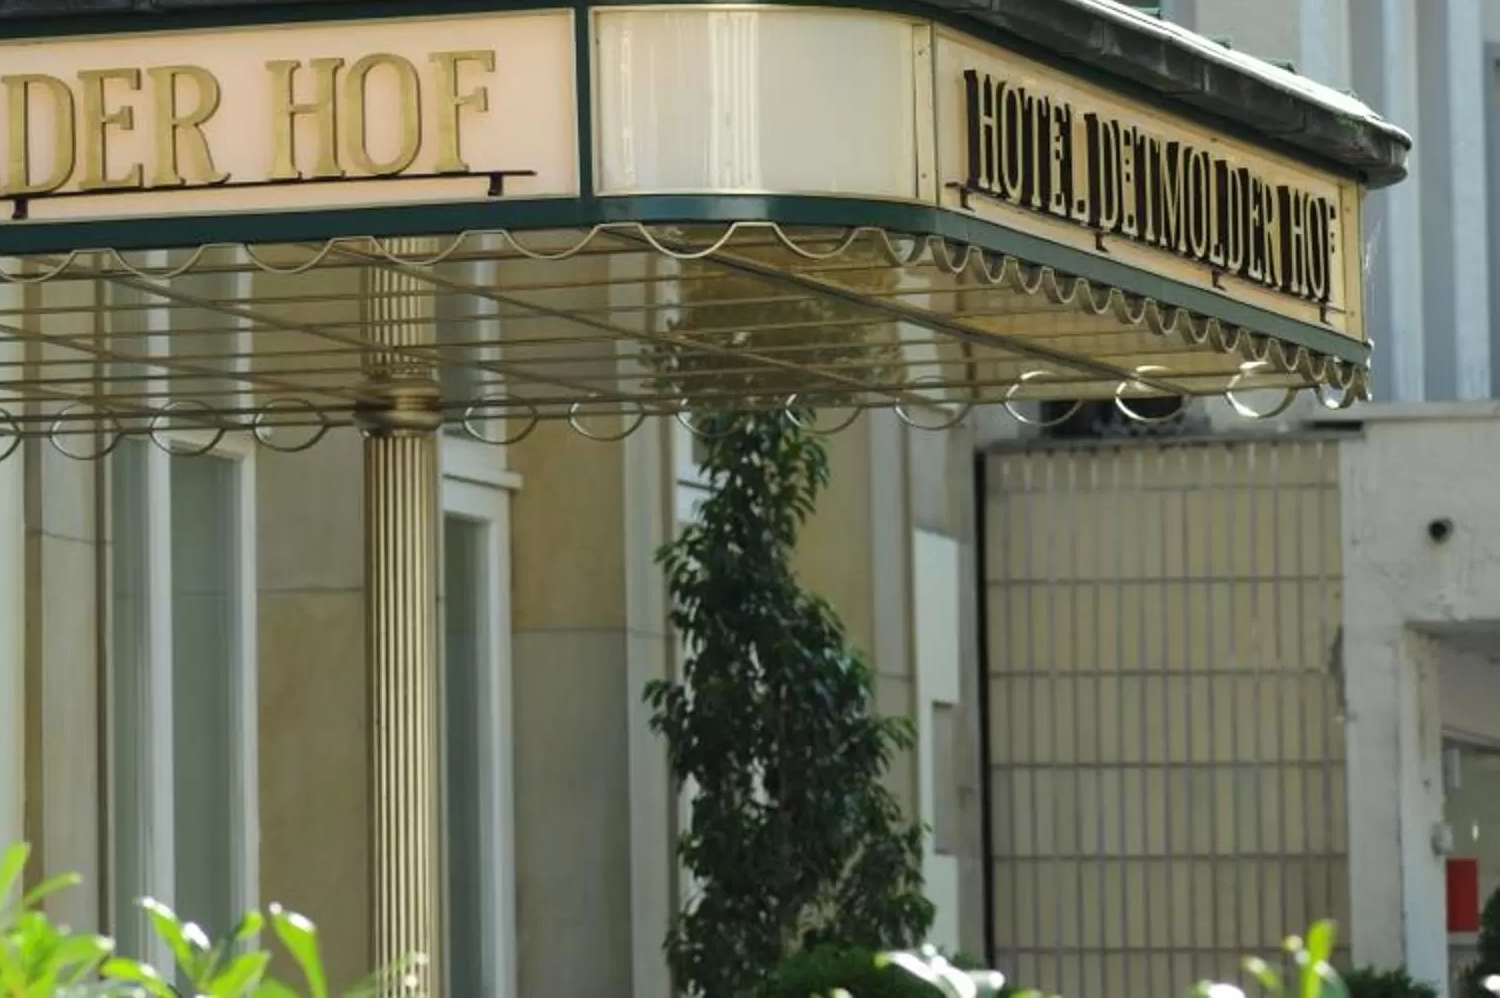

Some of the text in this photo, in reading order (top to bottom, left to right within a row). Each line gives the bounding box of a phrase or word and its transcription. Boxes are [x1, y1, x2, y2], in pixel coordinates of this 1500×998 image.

[265, 49, 496, 180] HOF
[964, 69, 1337, 302] HOTEL DETMOLDER HOF
